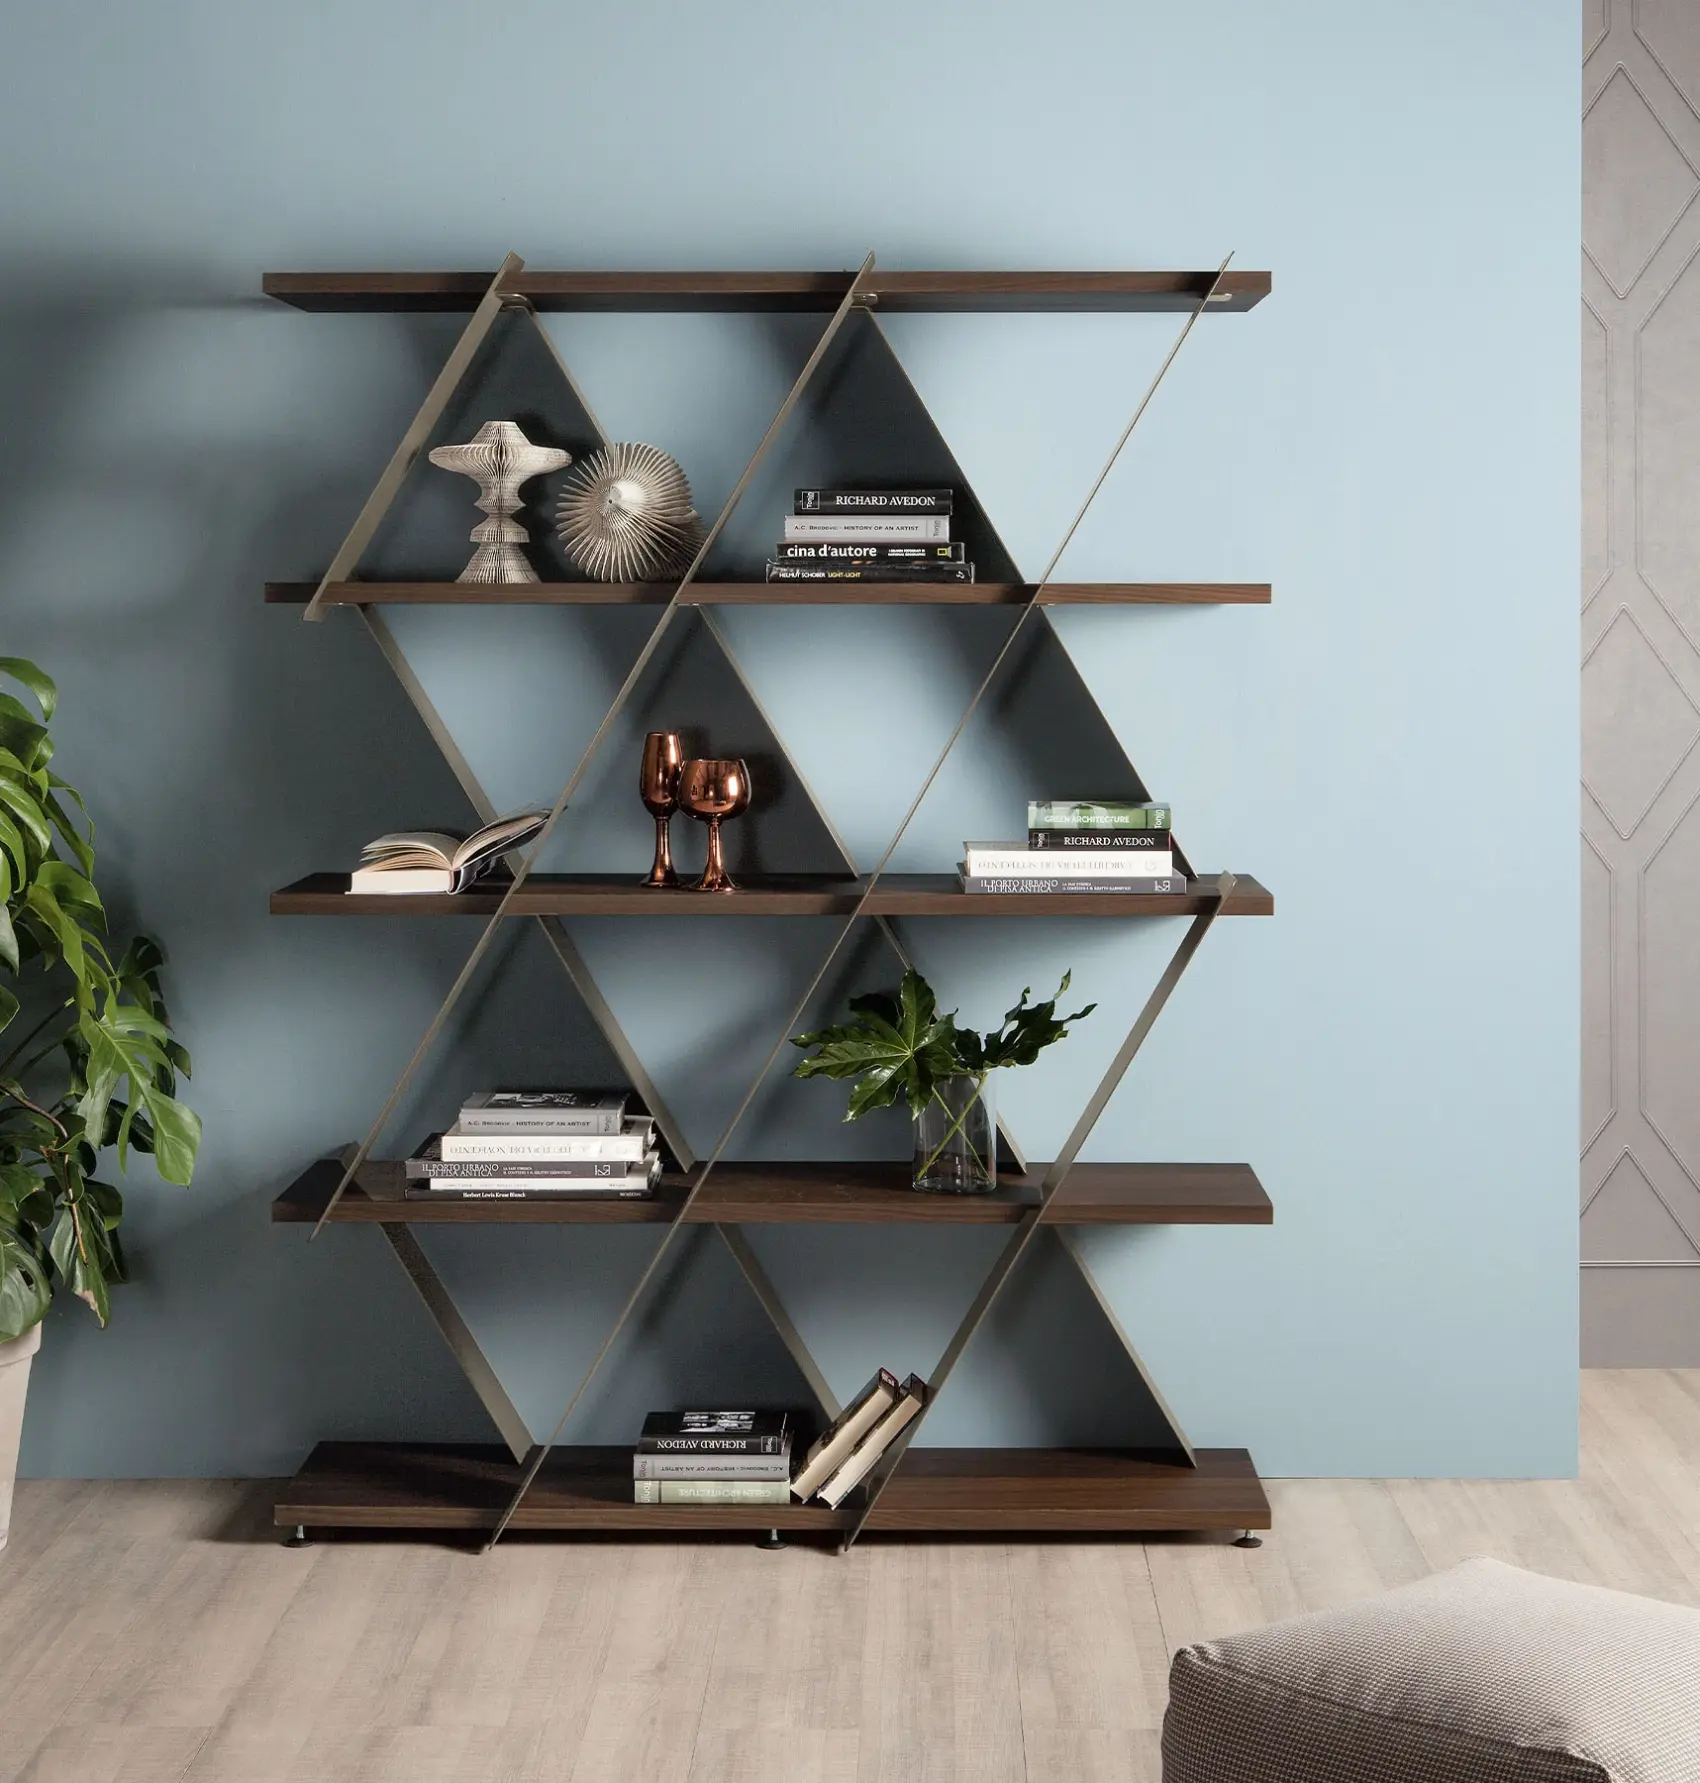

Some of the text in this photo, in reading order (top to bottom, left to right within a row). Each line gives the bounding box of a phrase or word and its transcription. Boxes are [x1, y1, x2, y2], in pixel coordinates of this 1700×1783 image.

[835, 495, 936, 506] RICHARD AVEDON
[787, 544, 877, 557] cina d'autore
[1044, 815, 1130, 824] GREEN ARCHITECTURE
[1064, 837, 1155, 846] RICHARD AVEDON
[989, 879, 1020, 888] PORTO
[1021, 879, 1059, 888] URBANO
[449, 1146, 506, 1155] NOVECENTO
[431, 1163, 461, 1172] PORTO
[462, 1163, 499, 1172] URBANO
[460, 1169, 493, 1177] ANTICA
[657, 1440, 747, 1449] RICHARD AVEDON
[678, 1488, 771, 1497] GREEN ARCHITECTURE
